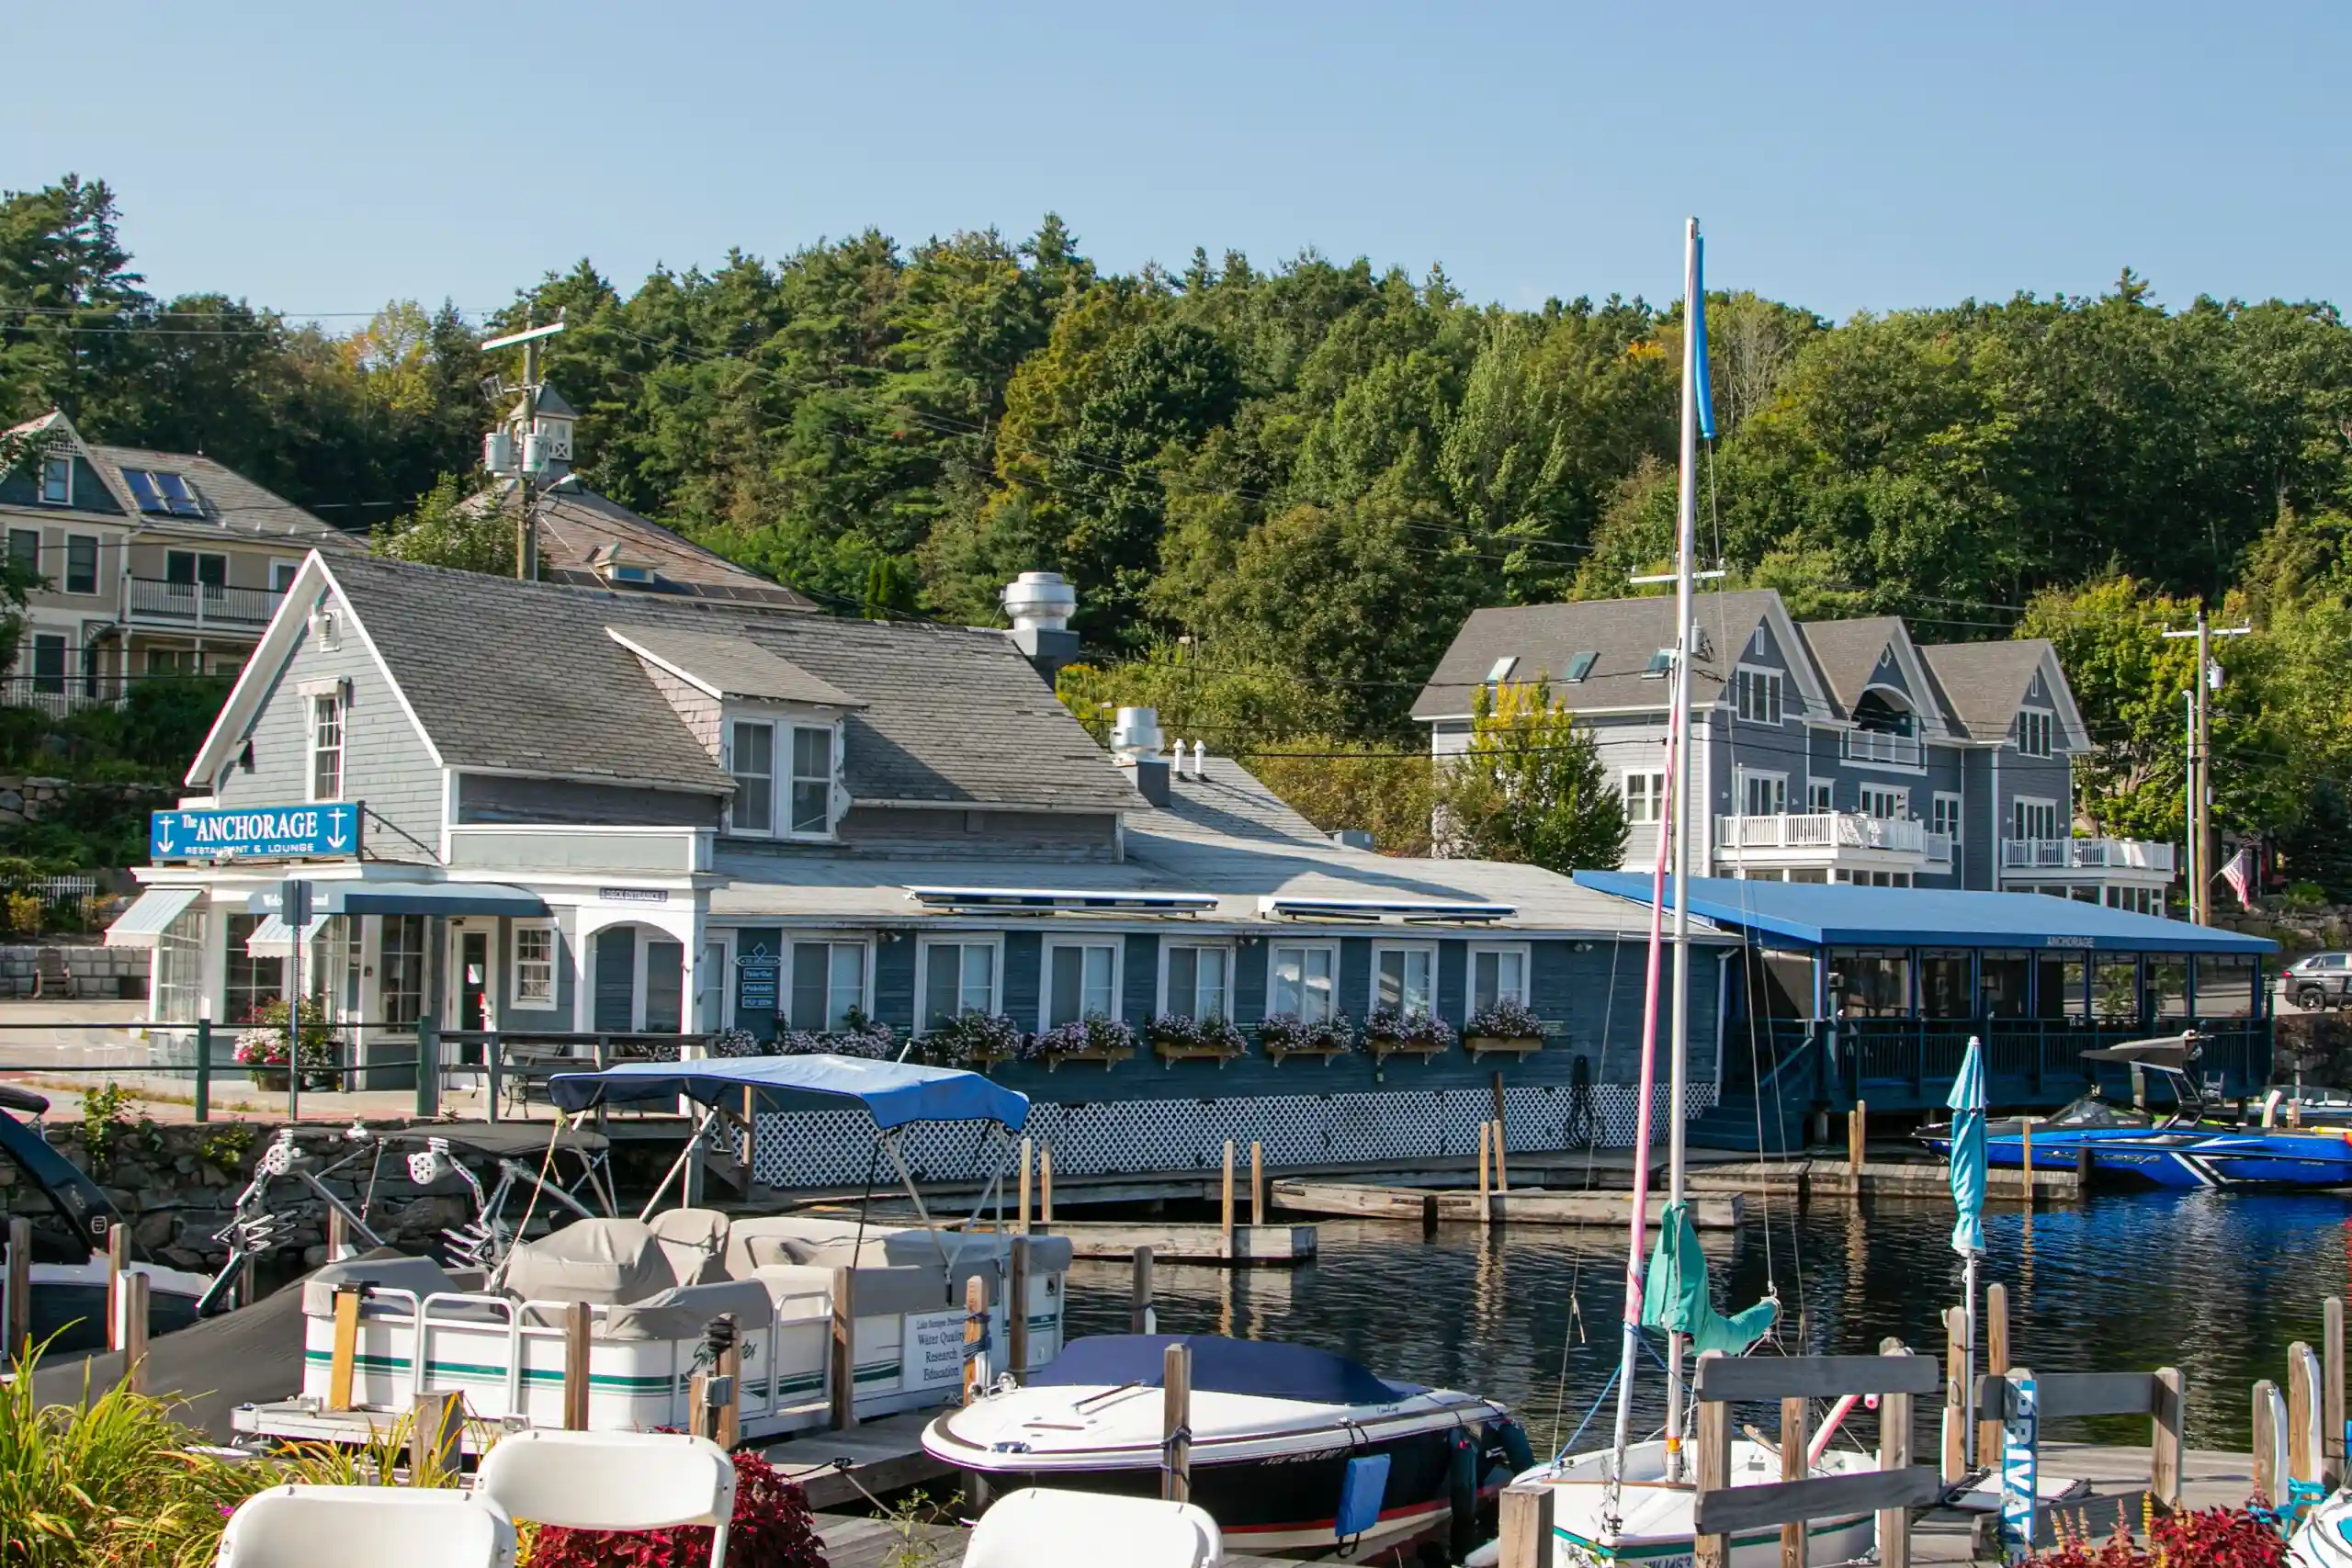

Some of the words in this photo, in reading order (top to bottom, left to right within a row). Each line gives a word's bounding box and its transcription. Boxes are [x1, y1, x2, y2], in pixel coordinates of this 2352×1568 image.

[182, 814, 198, 828] The
[196, 812, 318, 841] ANCHORAGE
[254, 844, 261, 853] &
[268, 843, 314, 852] LOUNGE
[2047, 936, 2095, 949] ANCHORAGE
[926, 1348, 957, 1363] Research
[924, 1366, 959, 1381] Education
